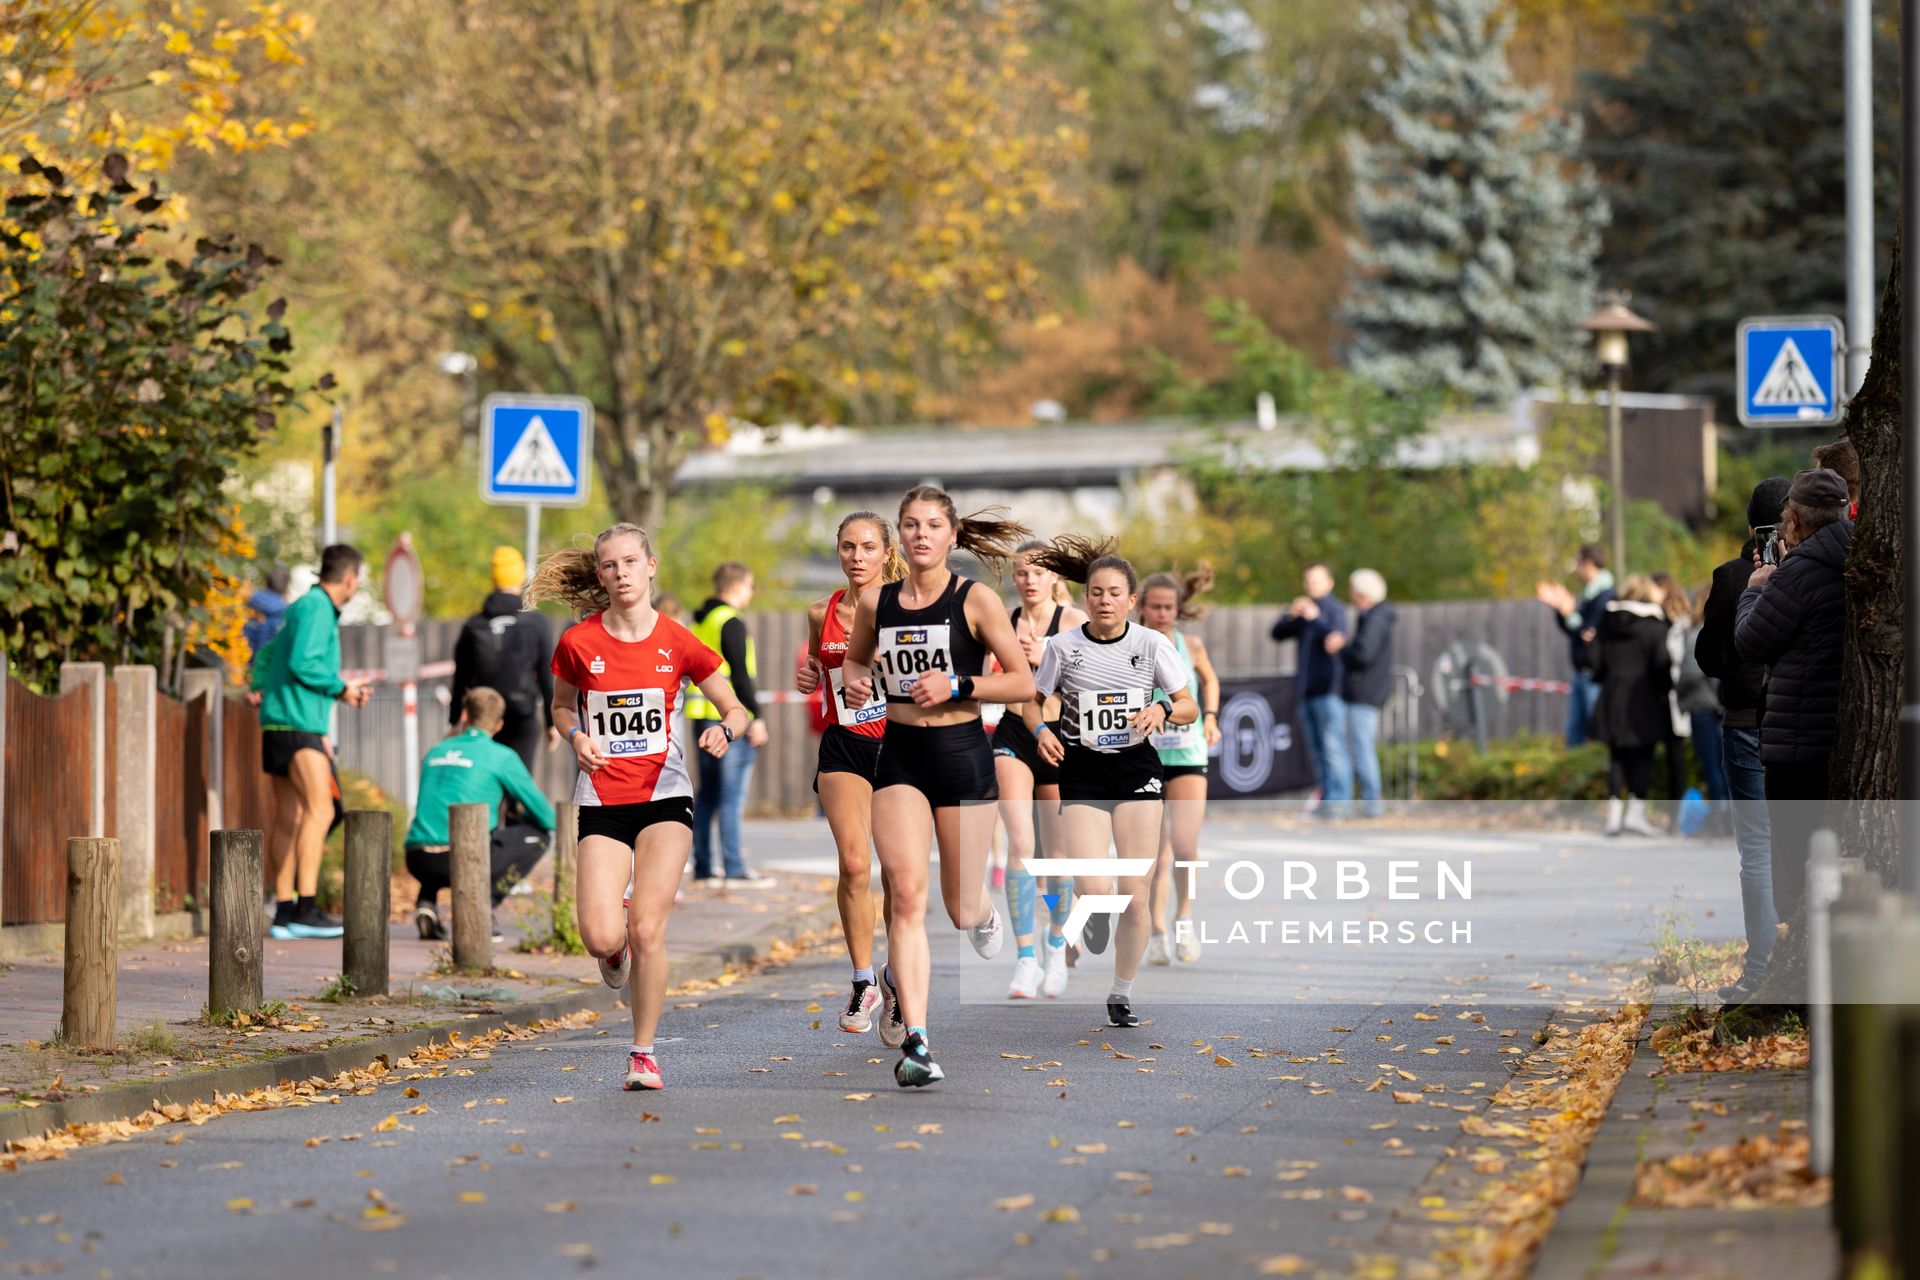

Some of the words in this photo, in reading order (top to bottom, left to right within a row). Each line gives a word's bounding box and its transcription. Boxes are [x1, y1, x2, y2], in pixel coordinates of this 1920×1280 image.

[912, 634, 925, 642] GLS
[882, 648, 948, 675] 1084
[627, 697, 641, 706] GLS
[593, 708, 662, 736] 1046
